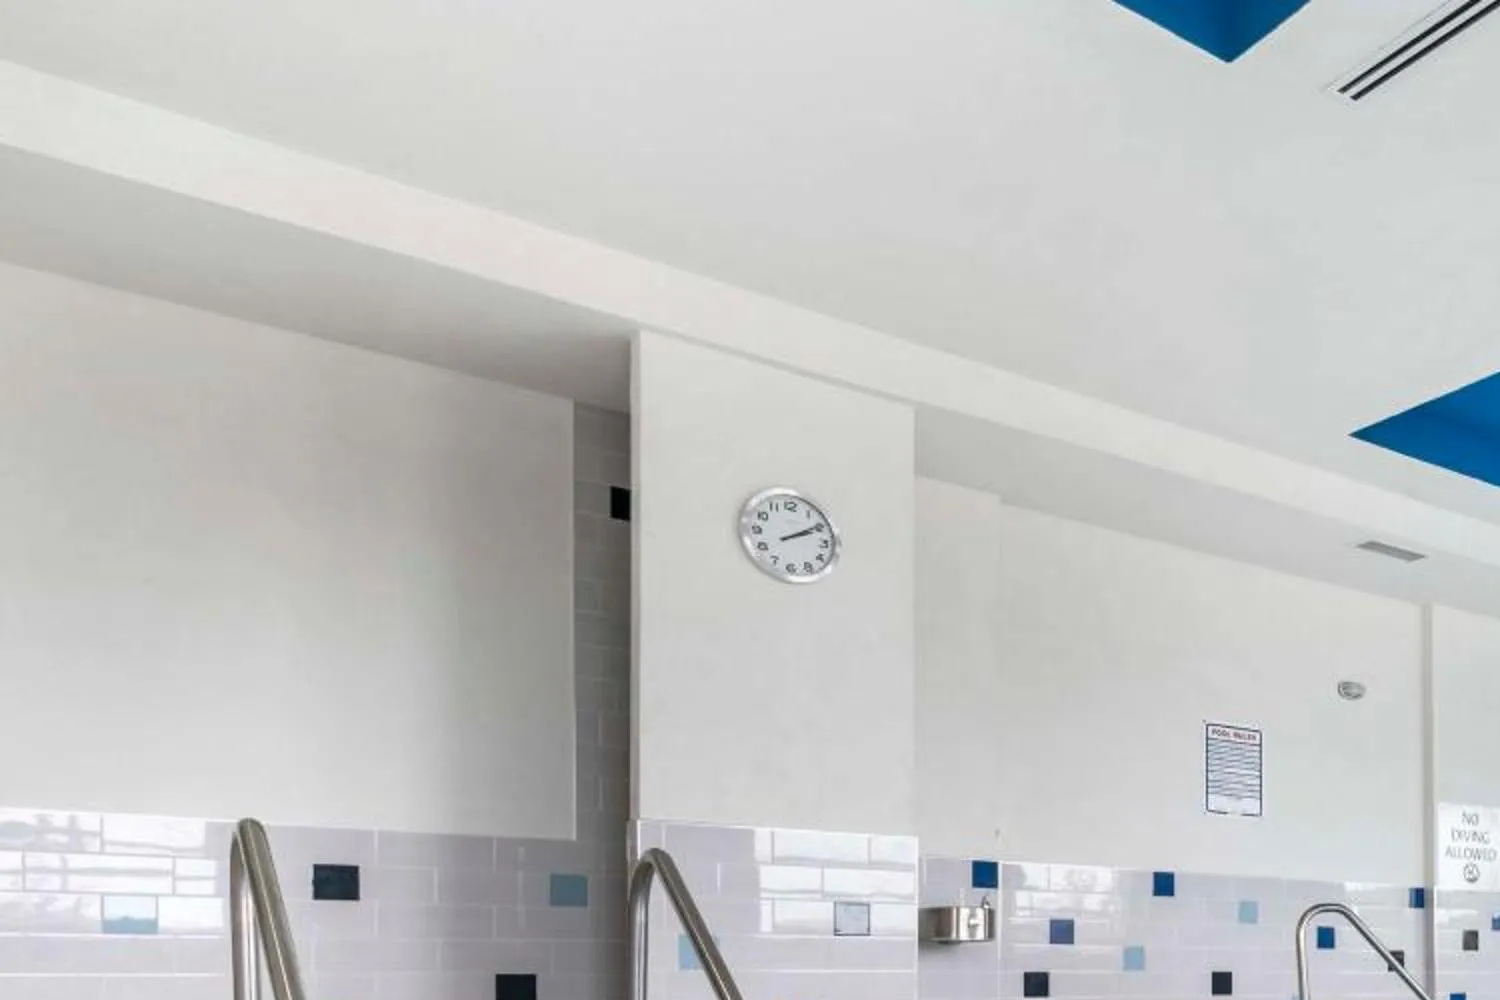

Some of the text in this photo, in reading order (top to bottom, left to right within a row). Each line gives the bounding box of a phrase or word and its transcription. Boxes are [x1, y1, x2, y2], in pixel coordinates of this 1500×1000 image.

[769, 501, 779, 512] 11
[784, 501, 797, 512] 12
[1462, 811, 1479, 826] NO
[1451, 827, 1490, 845] DIVING
[1445, 845, 1497, 861] ALLOWED
